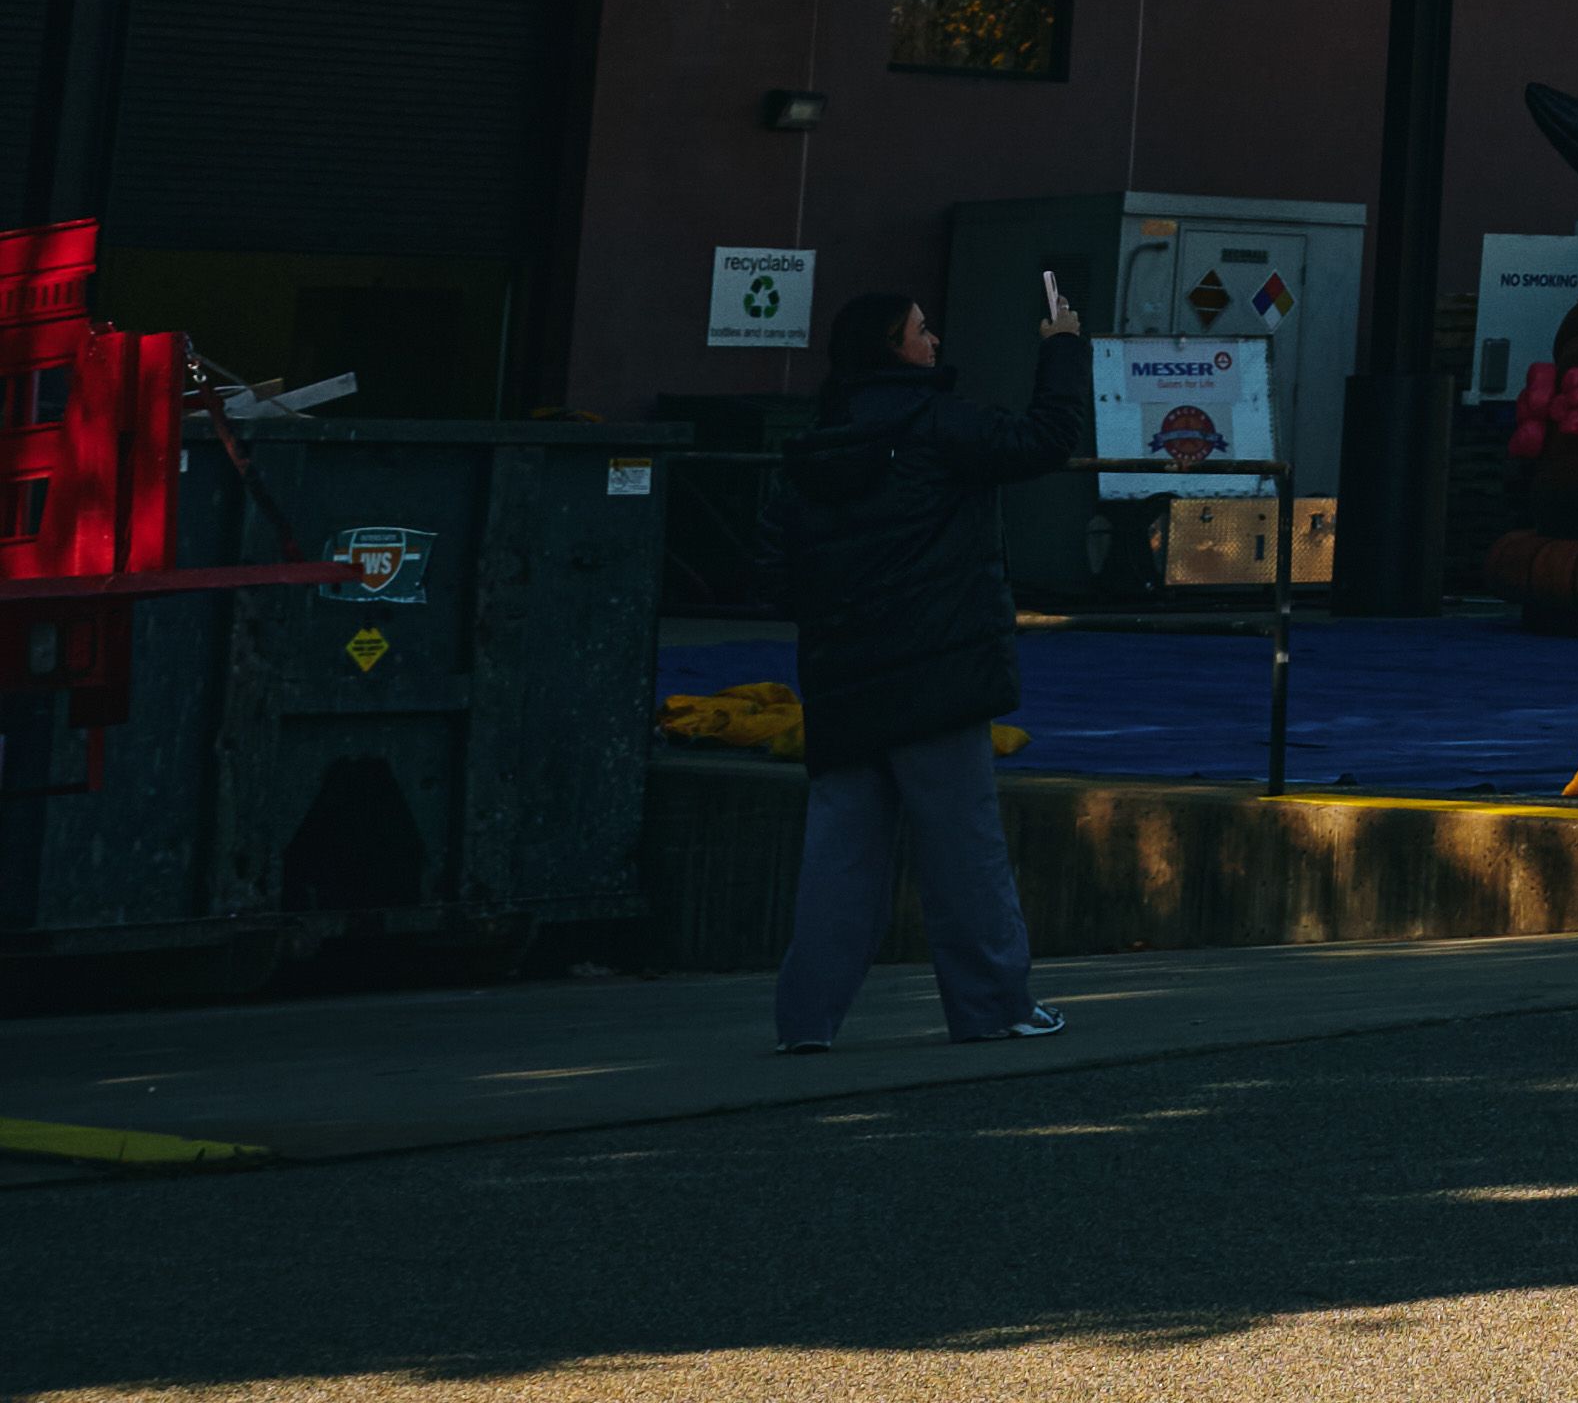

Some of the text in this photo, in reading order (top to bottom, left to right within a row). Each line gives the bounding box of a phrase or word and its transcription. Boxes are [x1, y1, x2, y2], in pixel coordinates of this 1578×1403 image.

[724, 254, 805, 275] recyclable
[1500, 273, 1578, 287] NO SMOKING
[1131, 362, 1214, 376] MESSER
